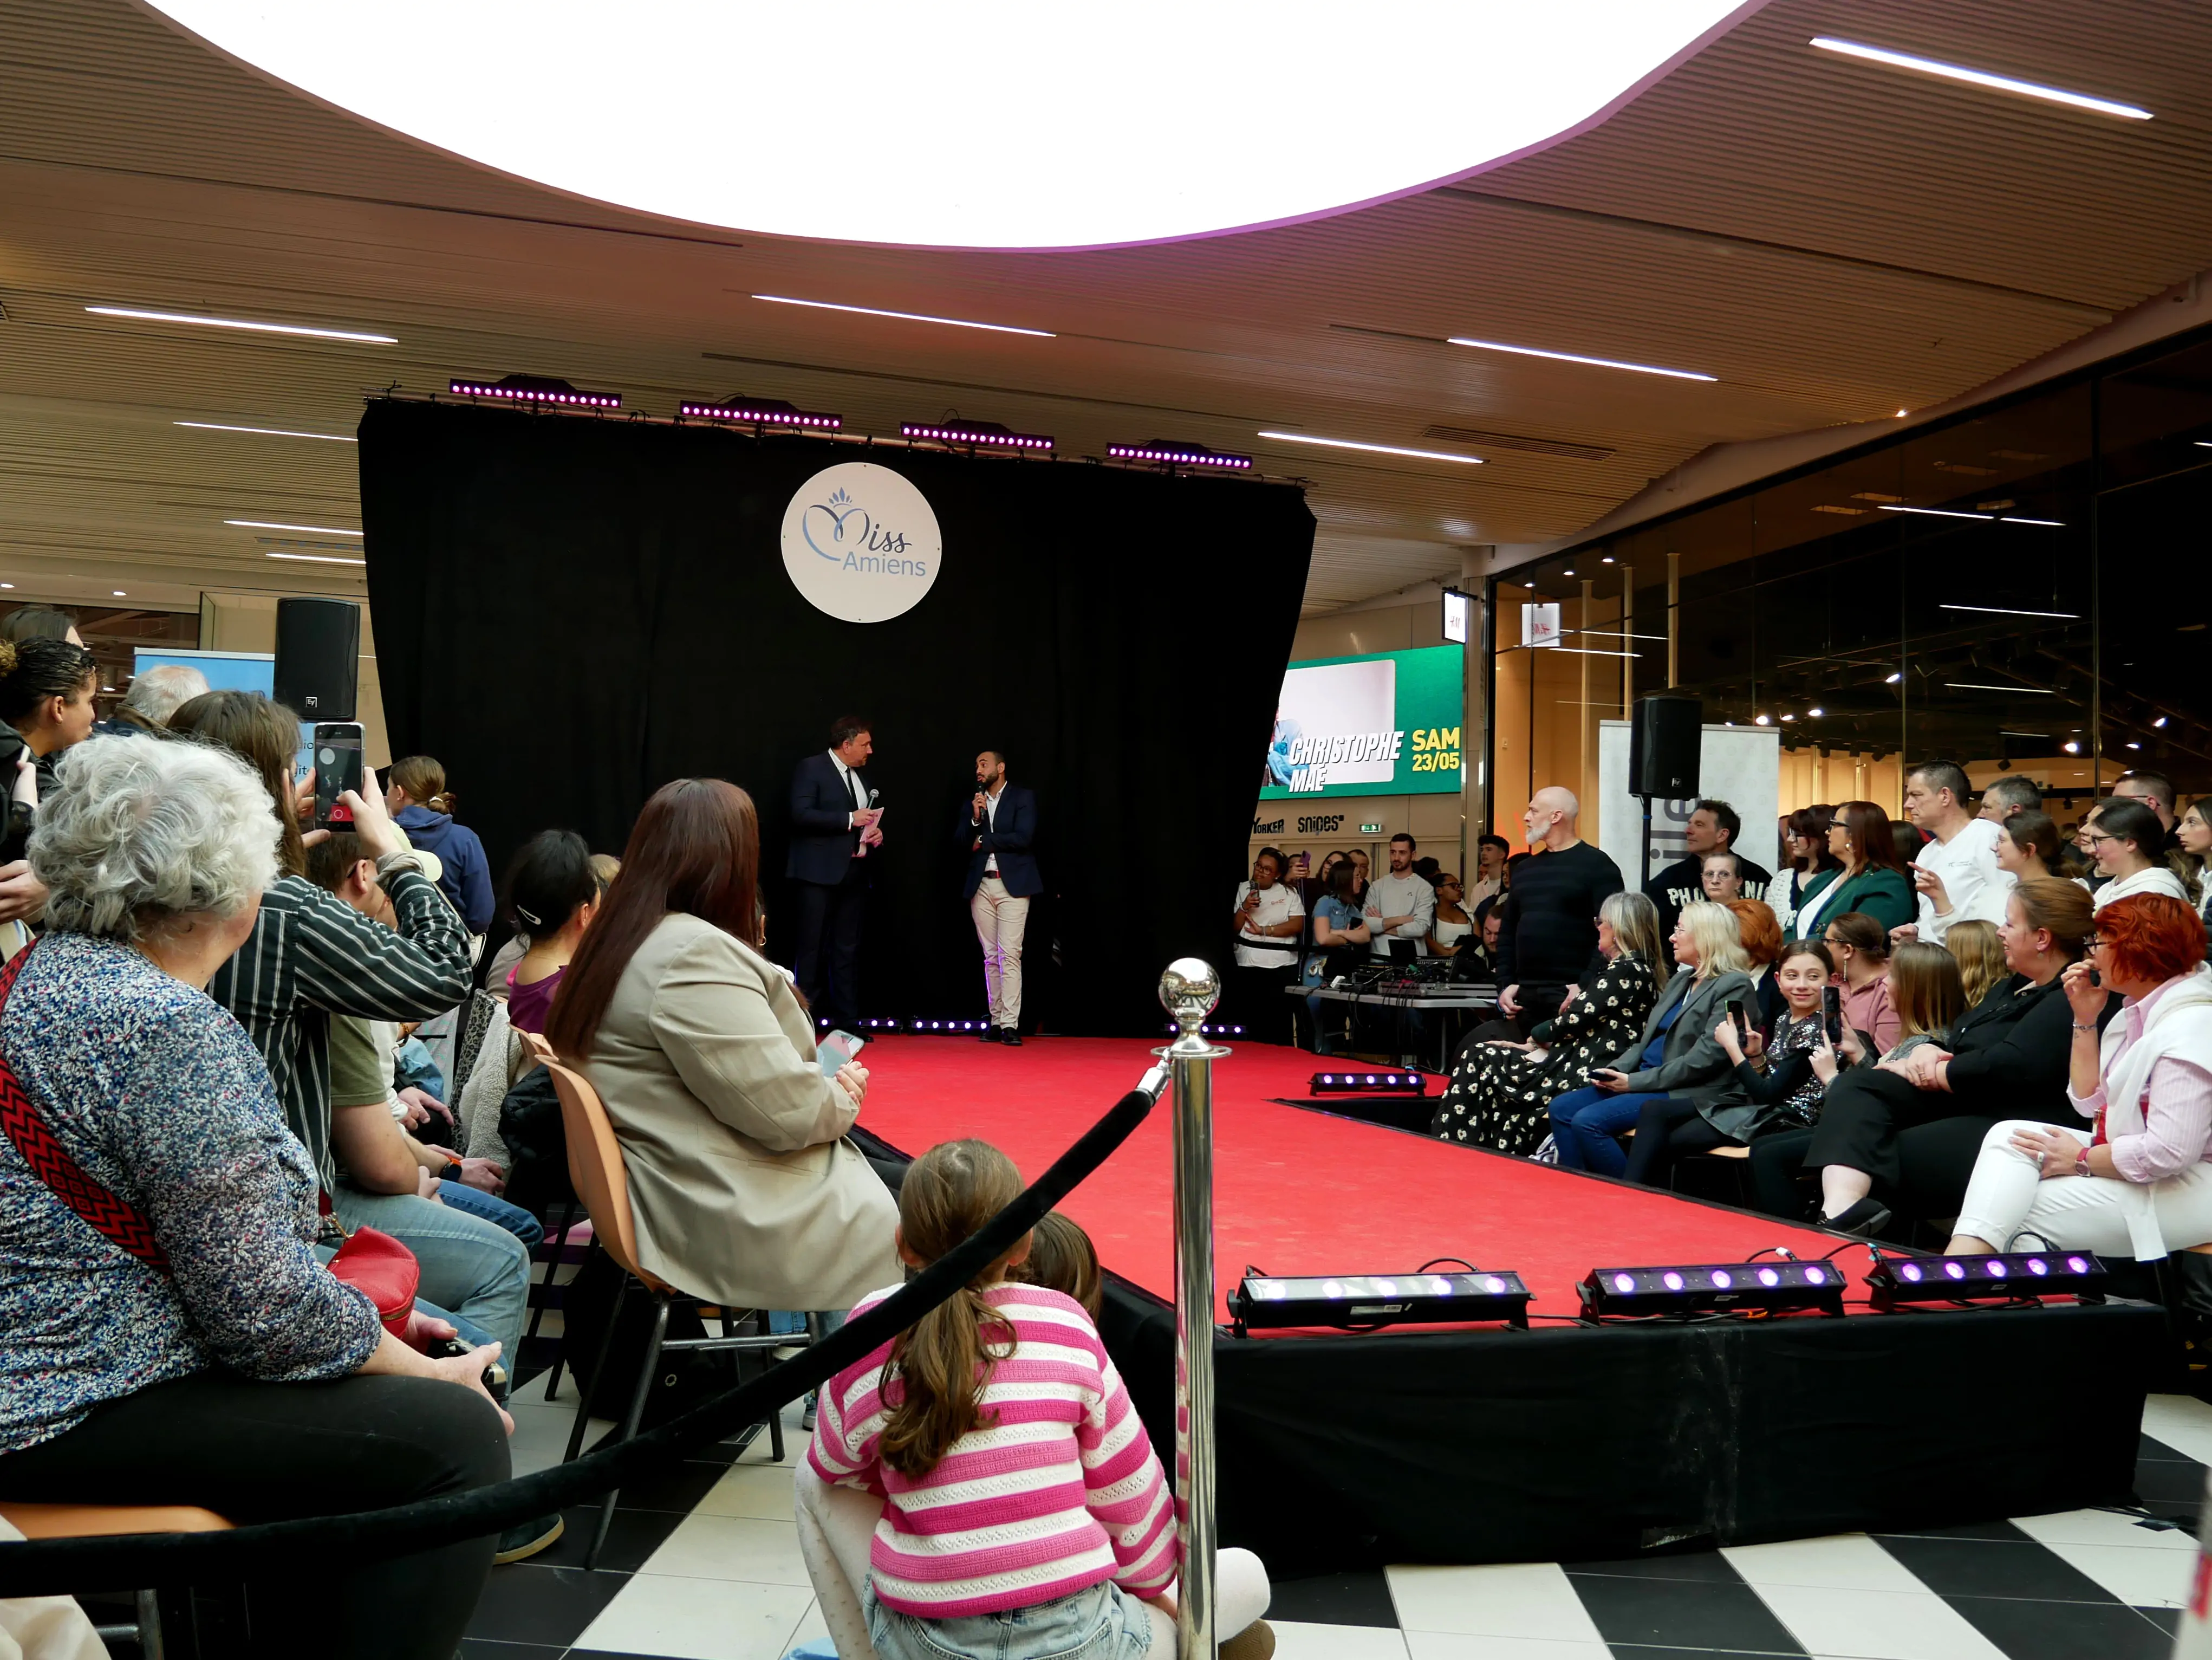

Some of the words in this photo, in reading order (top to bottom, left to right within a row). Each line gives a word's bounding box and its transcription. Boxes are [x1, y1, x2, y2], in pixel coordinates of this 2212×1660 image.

[802, 504, 913, 561] Miss
[843, 551, 926, 576] Amiens
[1289, 731, 1405, 766] CHRISTOPHE
[1411, 727, 1460, 751] SAM
[1411, 751, 1460, 773] 23/05
